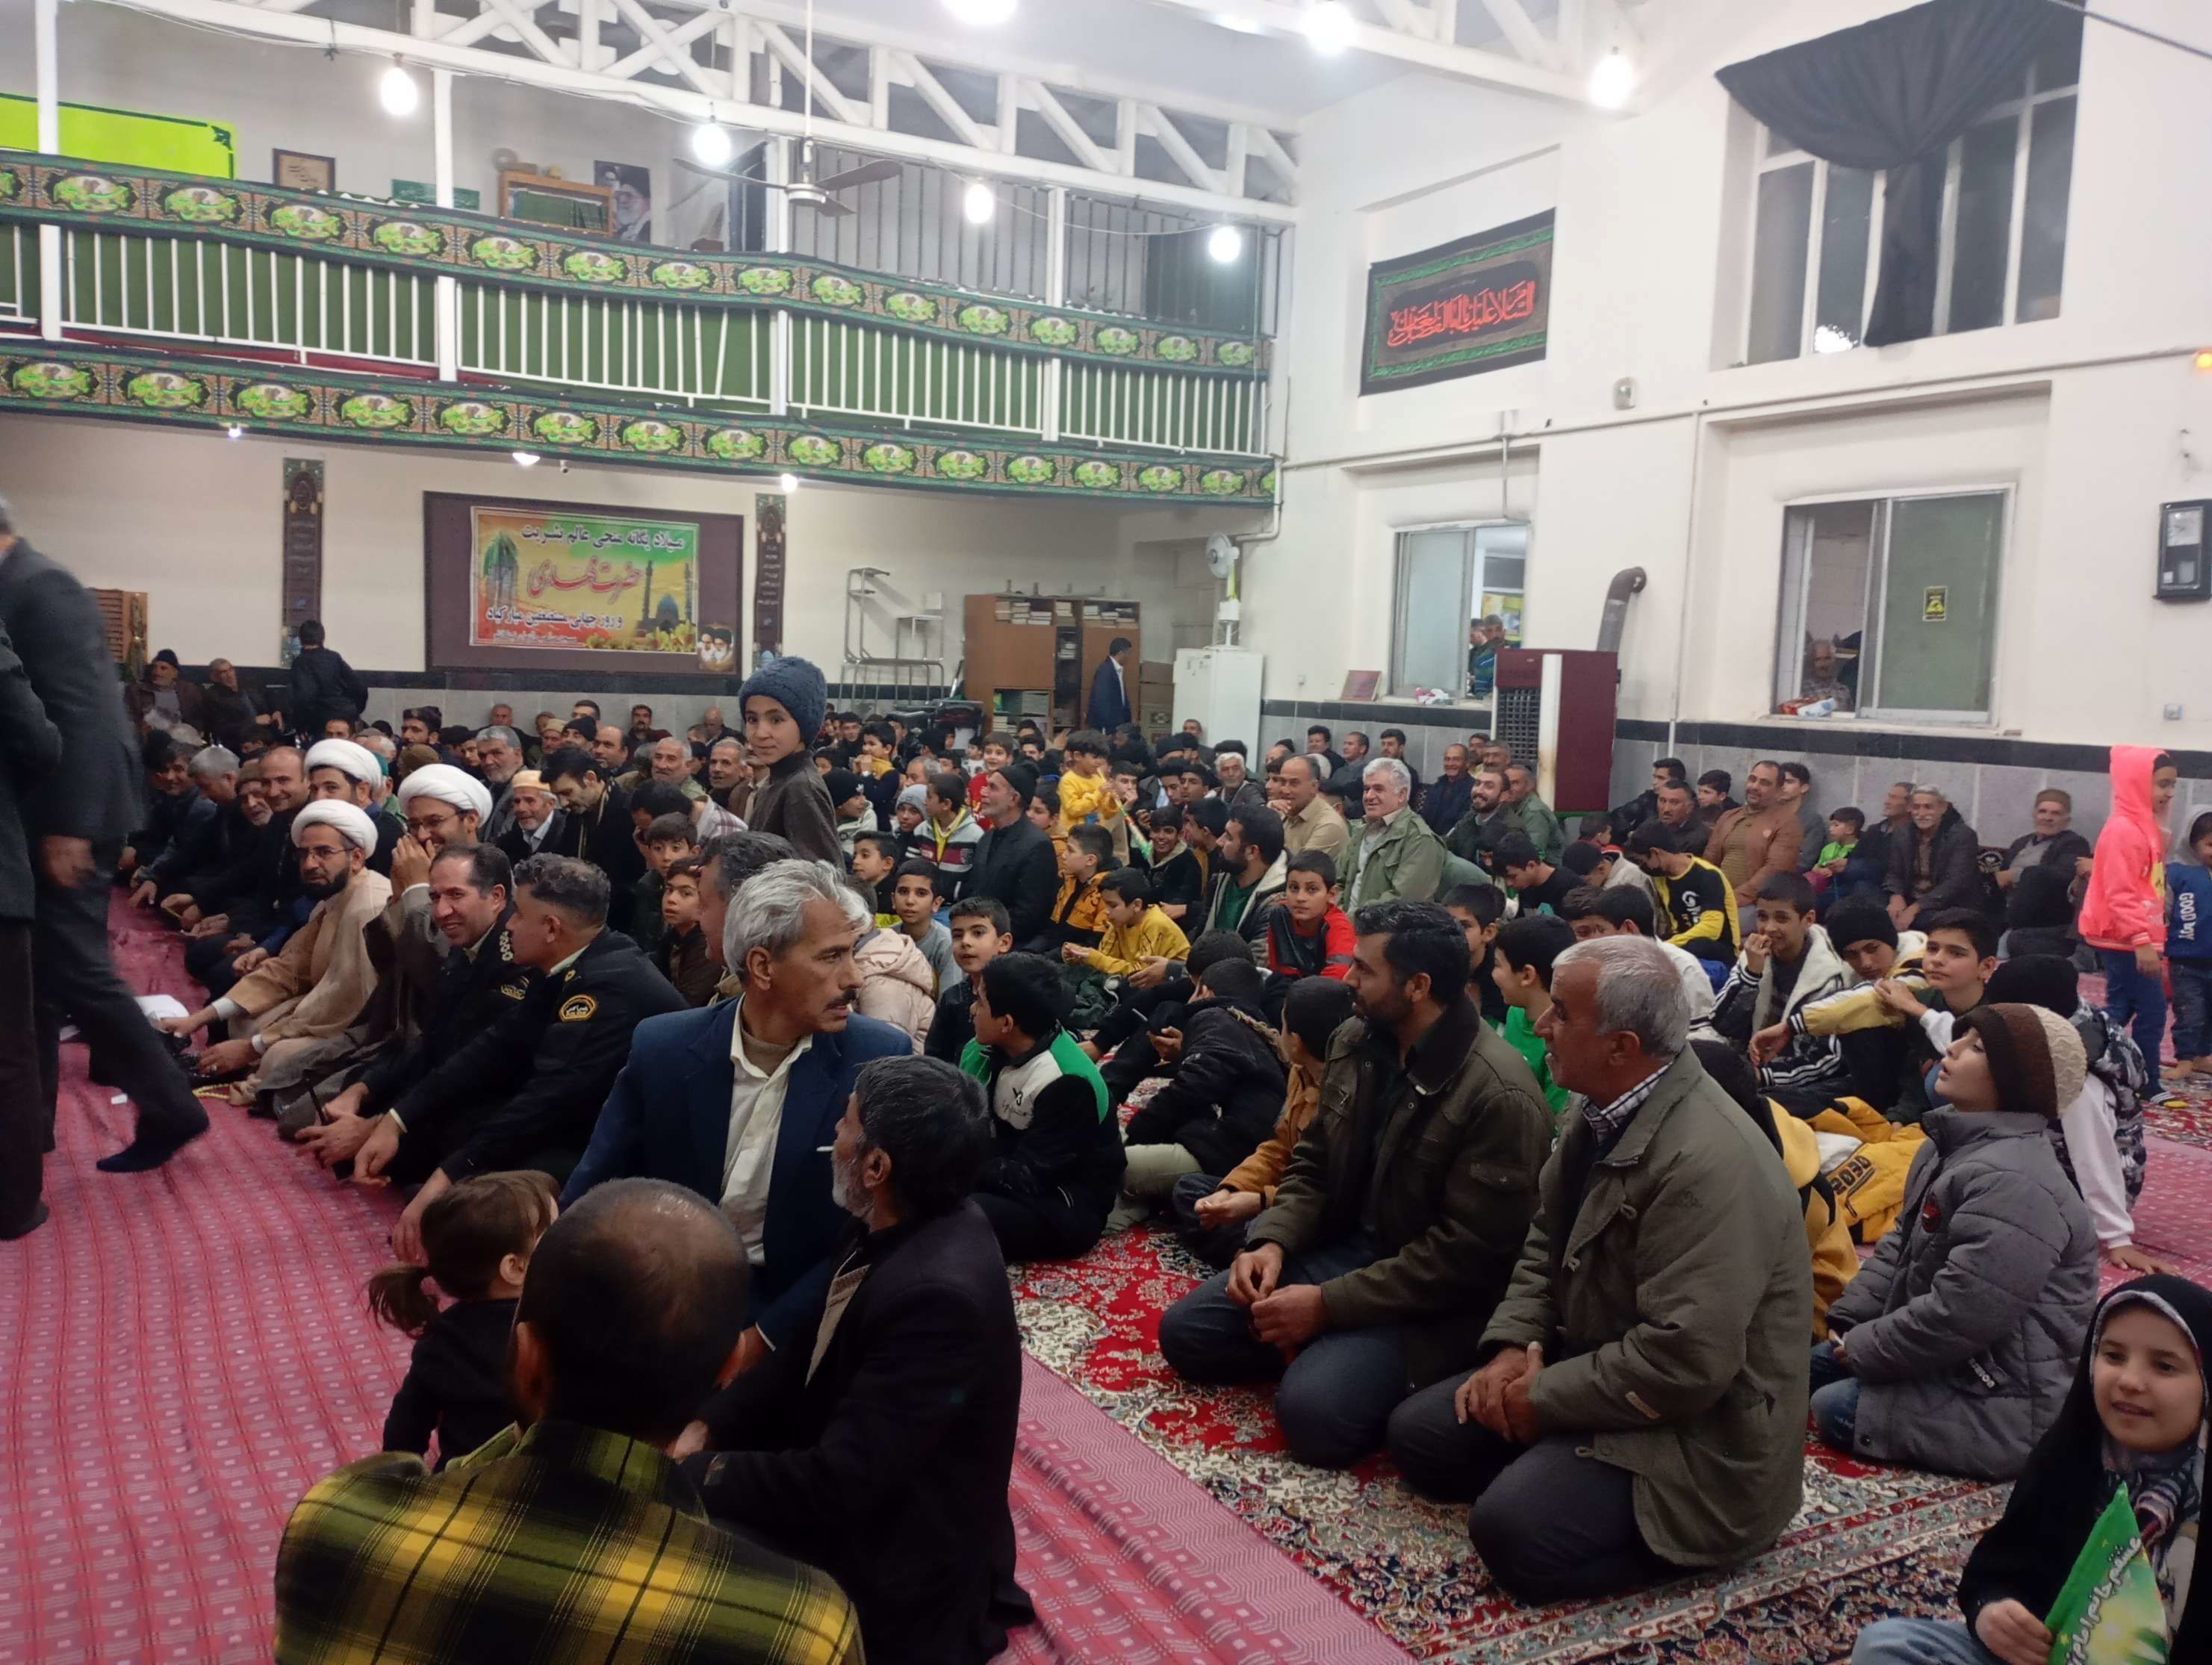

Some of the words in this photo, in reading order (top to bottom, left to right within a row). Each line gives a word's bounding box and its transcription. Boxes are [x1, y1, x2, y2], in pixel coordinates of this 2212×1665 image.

[521, 522, 563, 544] بشریت
[567, 525, 590, 546] عالم
[593, 530, 623, 548] منجی
[627, 529, 651, 551] یگانه
[653, 530, 684, 553] میلاد
[588, 559, 642, 605] حضرت
[525, 609, 568, 627] مستضعفین
[569, 610, 597, 630] جهانی
[599, 614, 615, 629] روز
[616, 615, 624, 630] و
[2178, 892, 2196, 921] GOOD
[1830, 1155, 1871, 1195] 2030
[2107, 1537, 2142, 1587] عشقم
